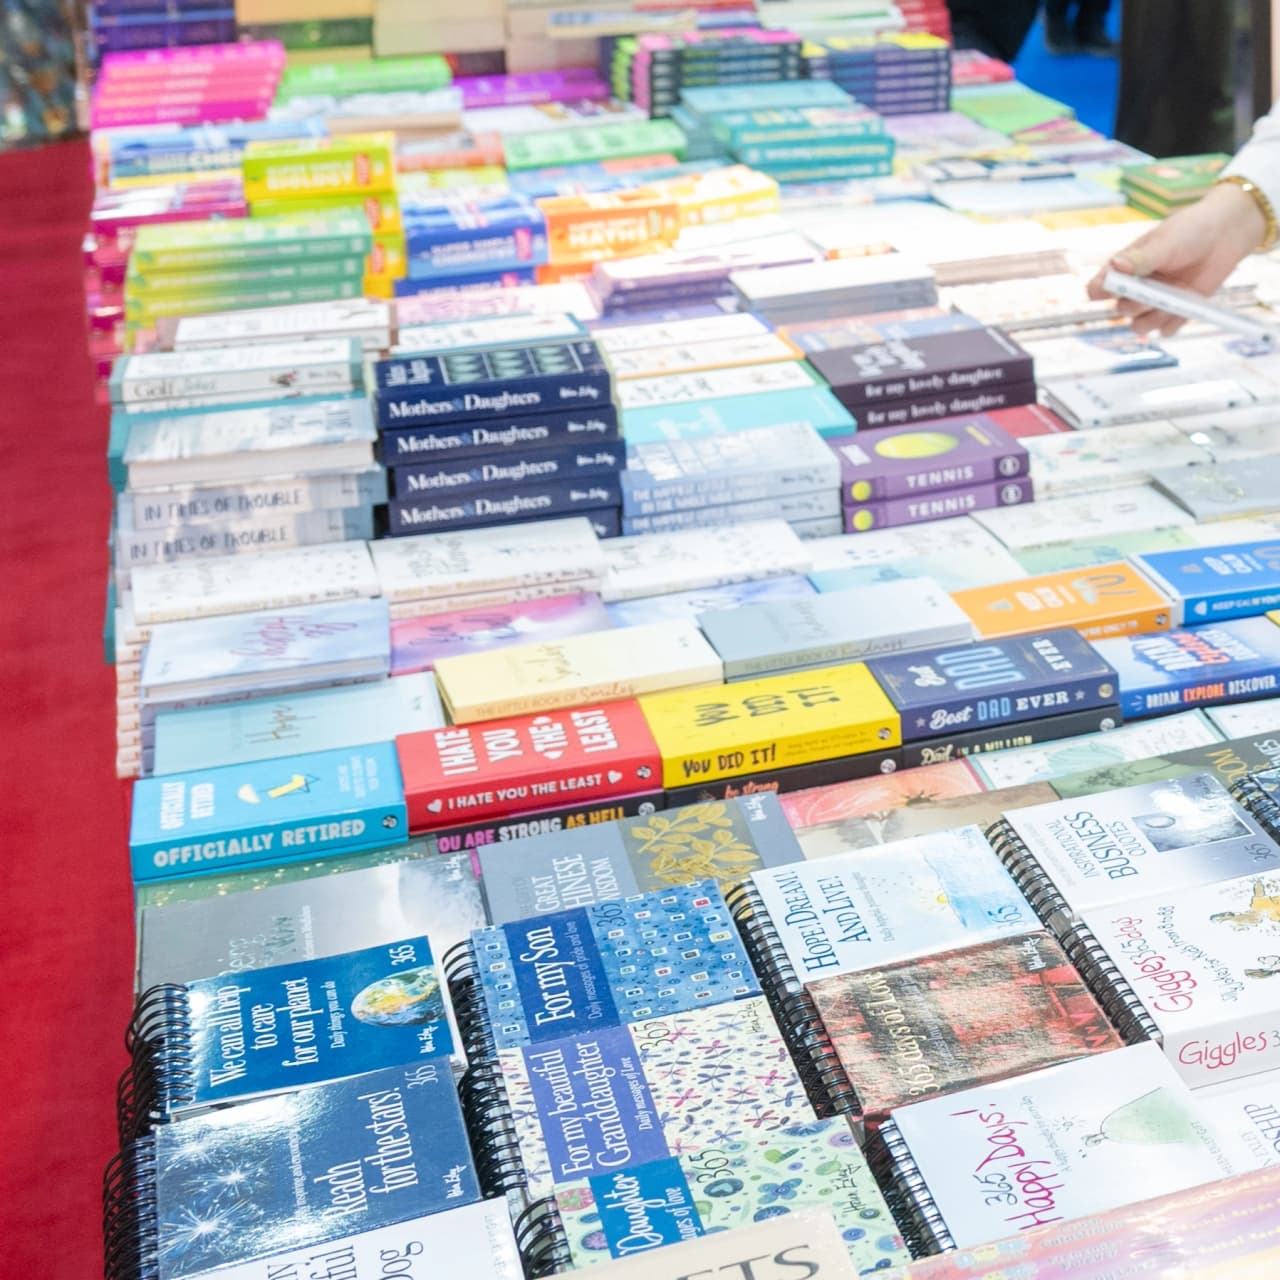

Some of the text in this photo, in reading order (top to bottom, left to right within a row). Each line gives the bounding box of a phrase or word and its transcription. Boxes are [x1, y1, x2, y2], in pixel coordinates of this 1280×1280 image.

[389, 400, 452, 418] Mothers
[464, 391, 541, 411] Daughters
[397, 436, 462, 454] Mothers
[473, 426, 548, 445] Daughters
[407, 472, 472, 492] Mothers
[482, 460, 558, 481] Daughters
[906, 466, 974, 488] TENNIS
[214, 496, 232, 513] OF
[401, 506, 465, 526] Mothers
[475, 496, 552, 516] Daughters
[908, 494, 976, 518] TENNIS
[201, 534, 217, 549] OF
[929, 691, 1070, 730] Best DAD EVER
[482, 728, 523, 762] YOU
[570, 709, 618, 753] LEAST
[718, 751, 744, 770] DID
[457, 792, 494, 809] HATE
[496, 787, 528, 801] YOU
[531, 783, 557, 795] THE
[560, 774, 602, 791] LEAST
[153, 818, 366, 868] OFFICIALLY RETIRED
[1063, 810, 1139, 880] BUSINESS
[1105, 820, 1148, 857] QUOTES
[531, 874, 561, 913] GREAT
[816, 873, 872, 944] AND LIVE!
[592, 902, 627, 928] 365
[776, 870, 842, 973] HOPE! DREAM!
[388, 944, 417, 966] 365
[519, 926, 577, 1026] For my Son
[250, 1002, 279, 1051] to care
[275, 976, 324, 1069] for our planet
[633, 1021, 676, 1051] 365
[1177, 1026, 1269, 1069] Giggles
[404, 1064, 439, 1089] 365
[529, 1047, 595, 1176] For my beautiful
[572, 1040, 632, 1168] Granddaughter
[689, 1149, 735, 1184] 365
[950, 1102, 1065, 1230] Happy Days!
[313, 1159, 369, 1219] Reach
[972, 1172, 1019, 1207] 365
[603, 1173, 666, 1256] Daughter
